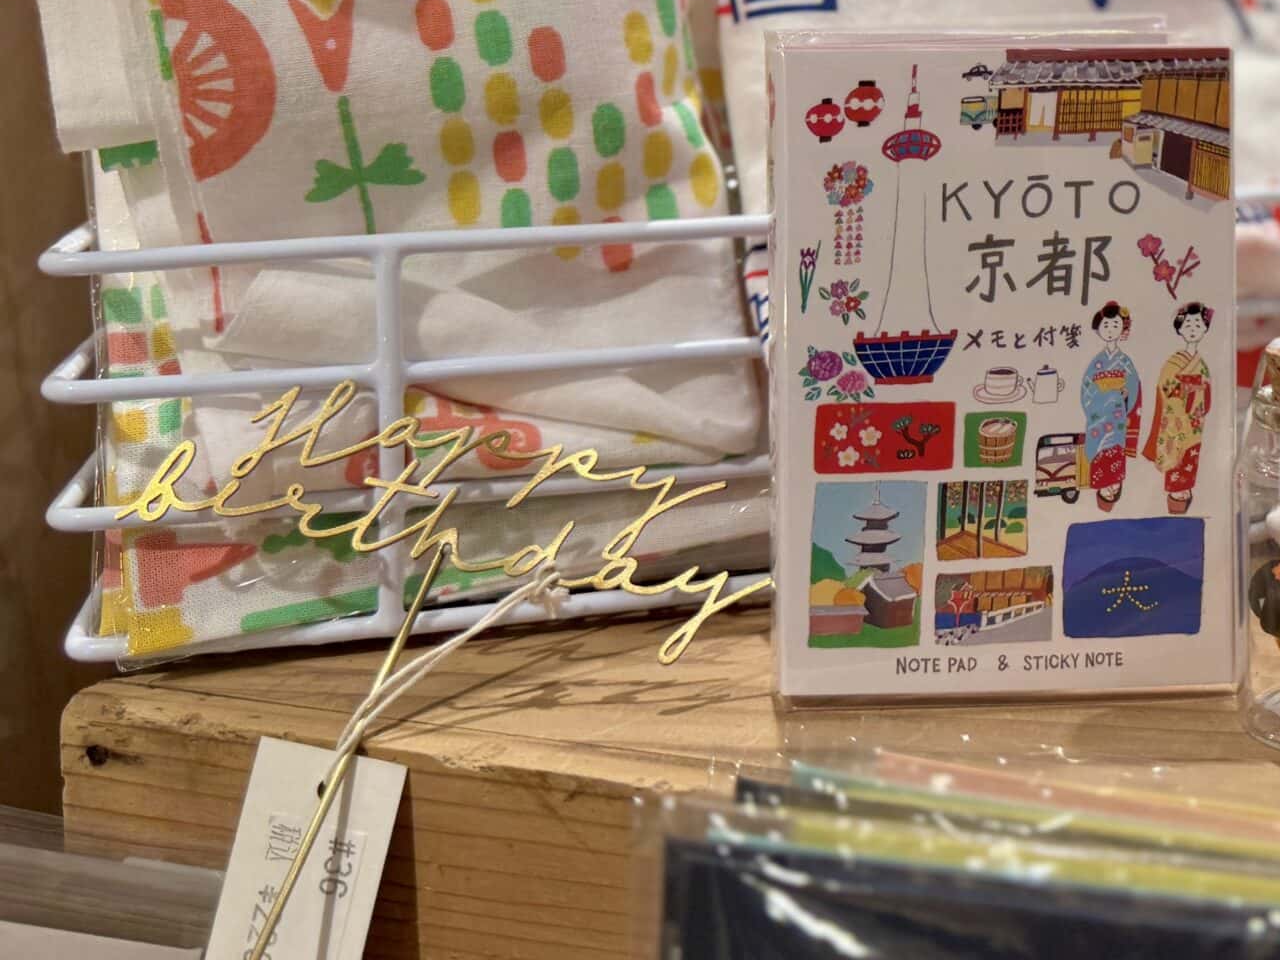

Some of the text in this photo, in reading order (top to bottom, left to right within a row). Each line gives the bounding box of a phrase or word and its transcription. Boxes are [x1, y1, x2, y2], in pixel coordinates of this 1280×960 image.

[941, 175, 1141, 222] KYŌTO
[966, 230, 1113, 306] 京都
[962, 323, 1083, 351] メモと付箋
[233, 378, 727, 563] Happy
[896, 651, 1124, 675] NOTE PAD & STICKY NOTE
[319, 839, 356, 899] #36
